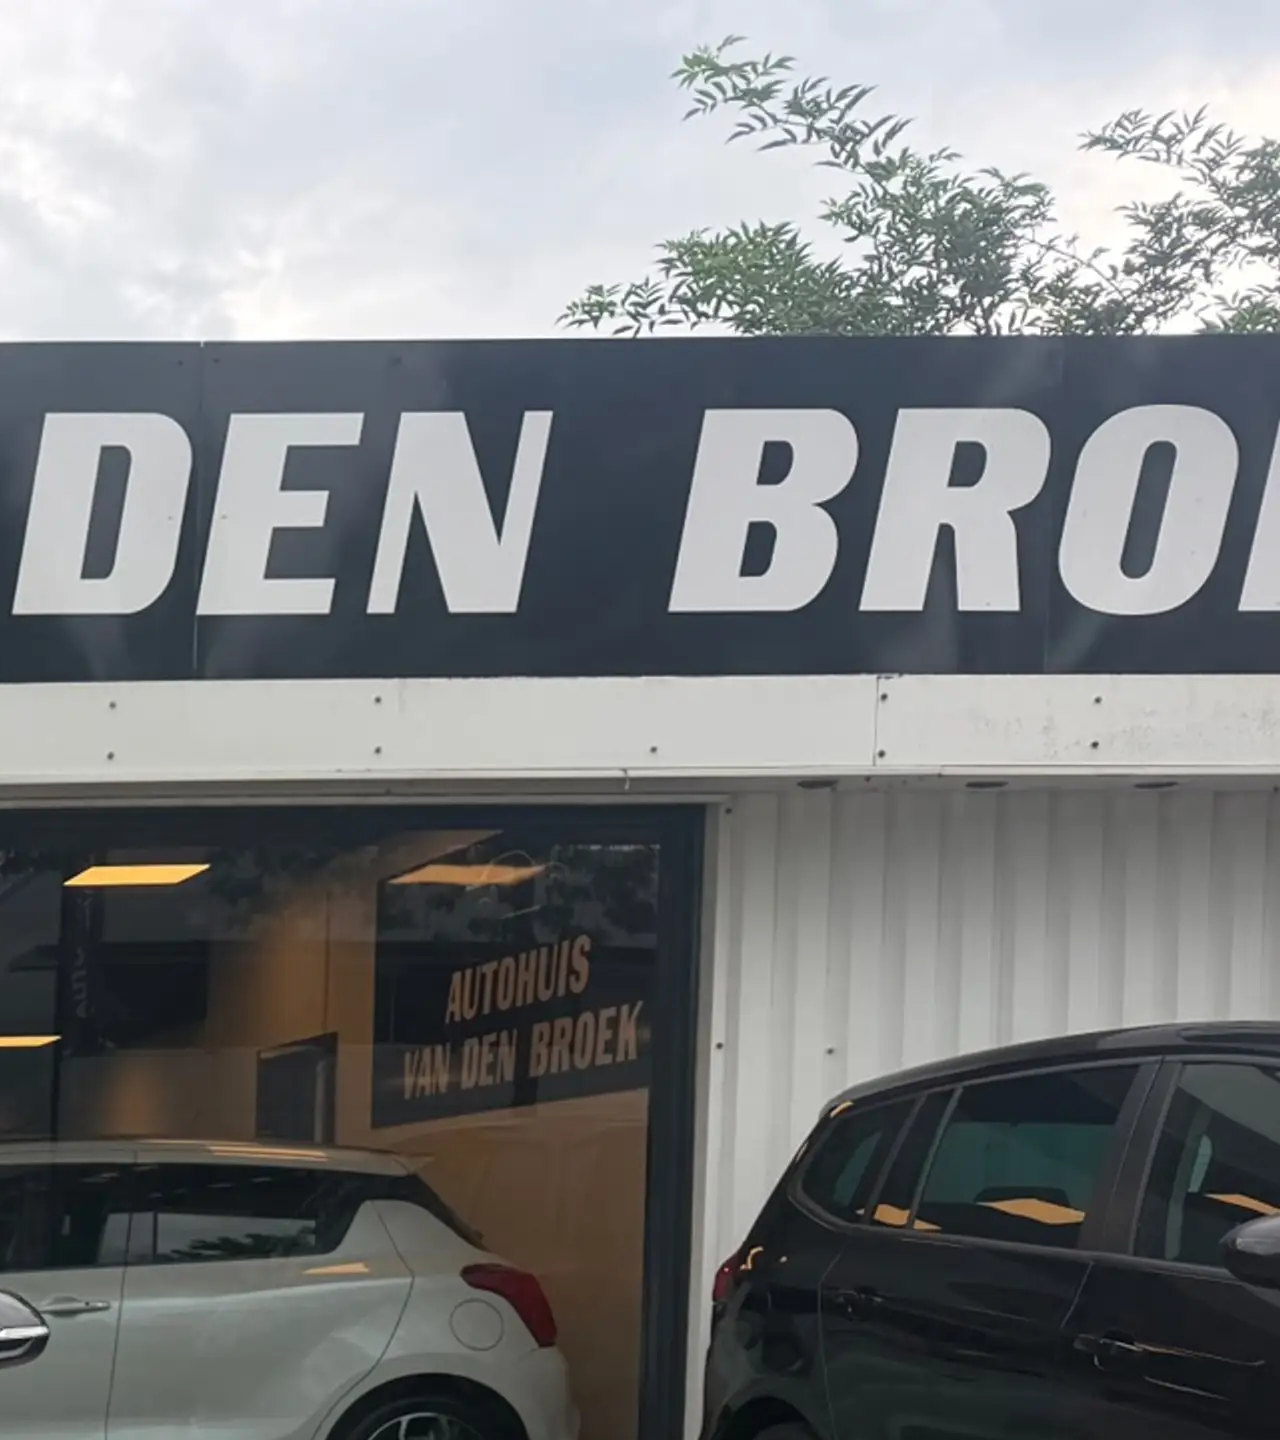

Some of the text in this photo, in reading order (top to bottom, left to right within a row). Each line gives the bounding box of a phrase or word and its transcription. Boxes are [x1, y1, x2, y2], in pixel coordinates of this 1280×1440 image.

[12, 410, 554, 616] DEN
[668, 404, 1280, 616] BRO
[445, 934, 591, 1024] AUTOHUIS
[404, 1000, 644, 1100] VAN DEN BROEK
